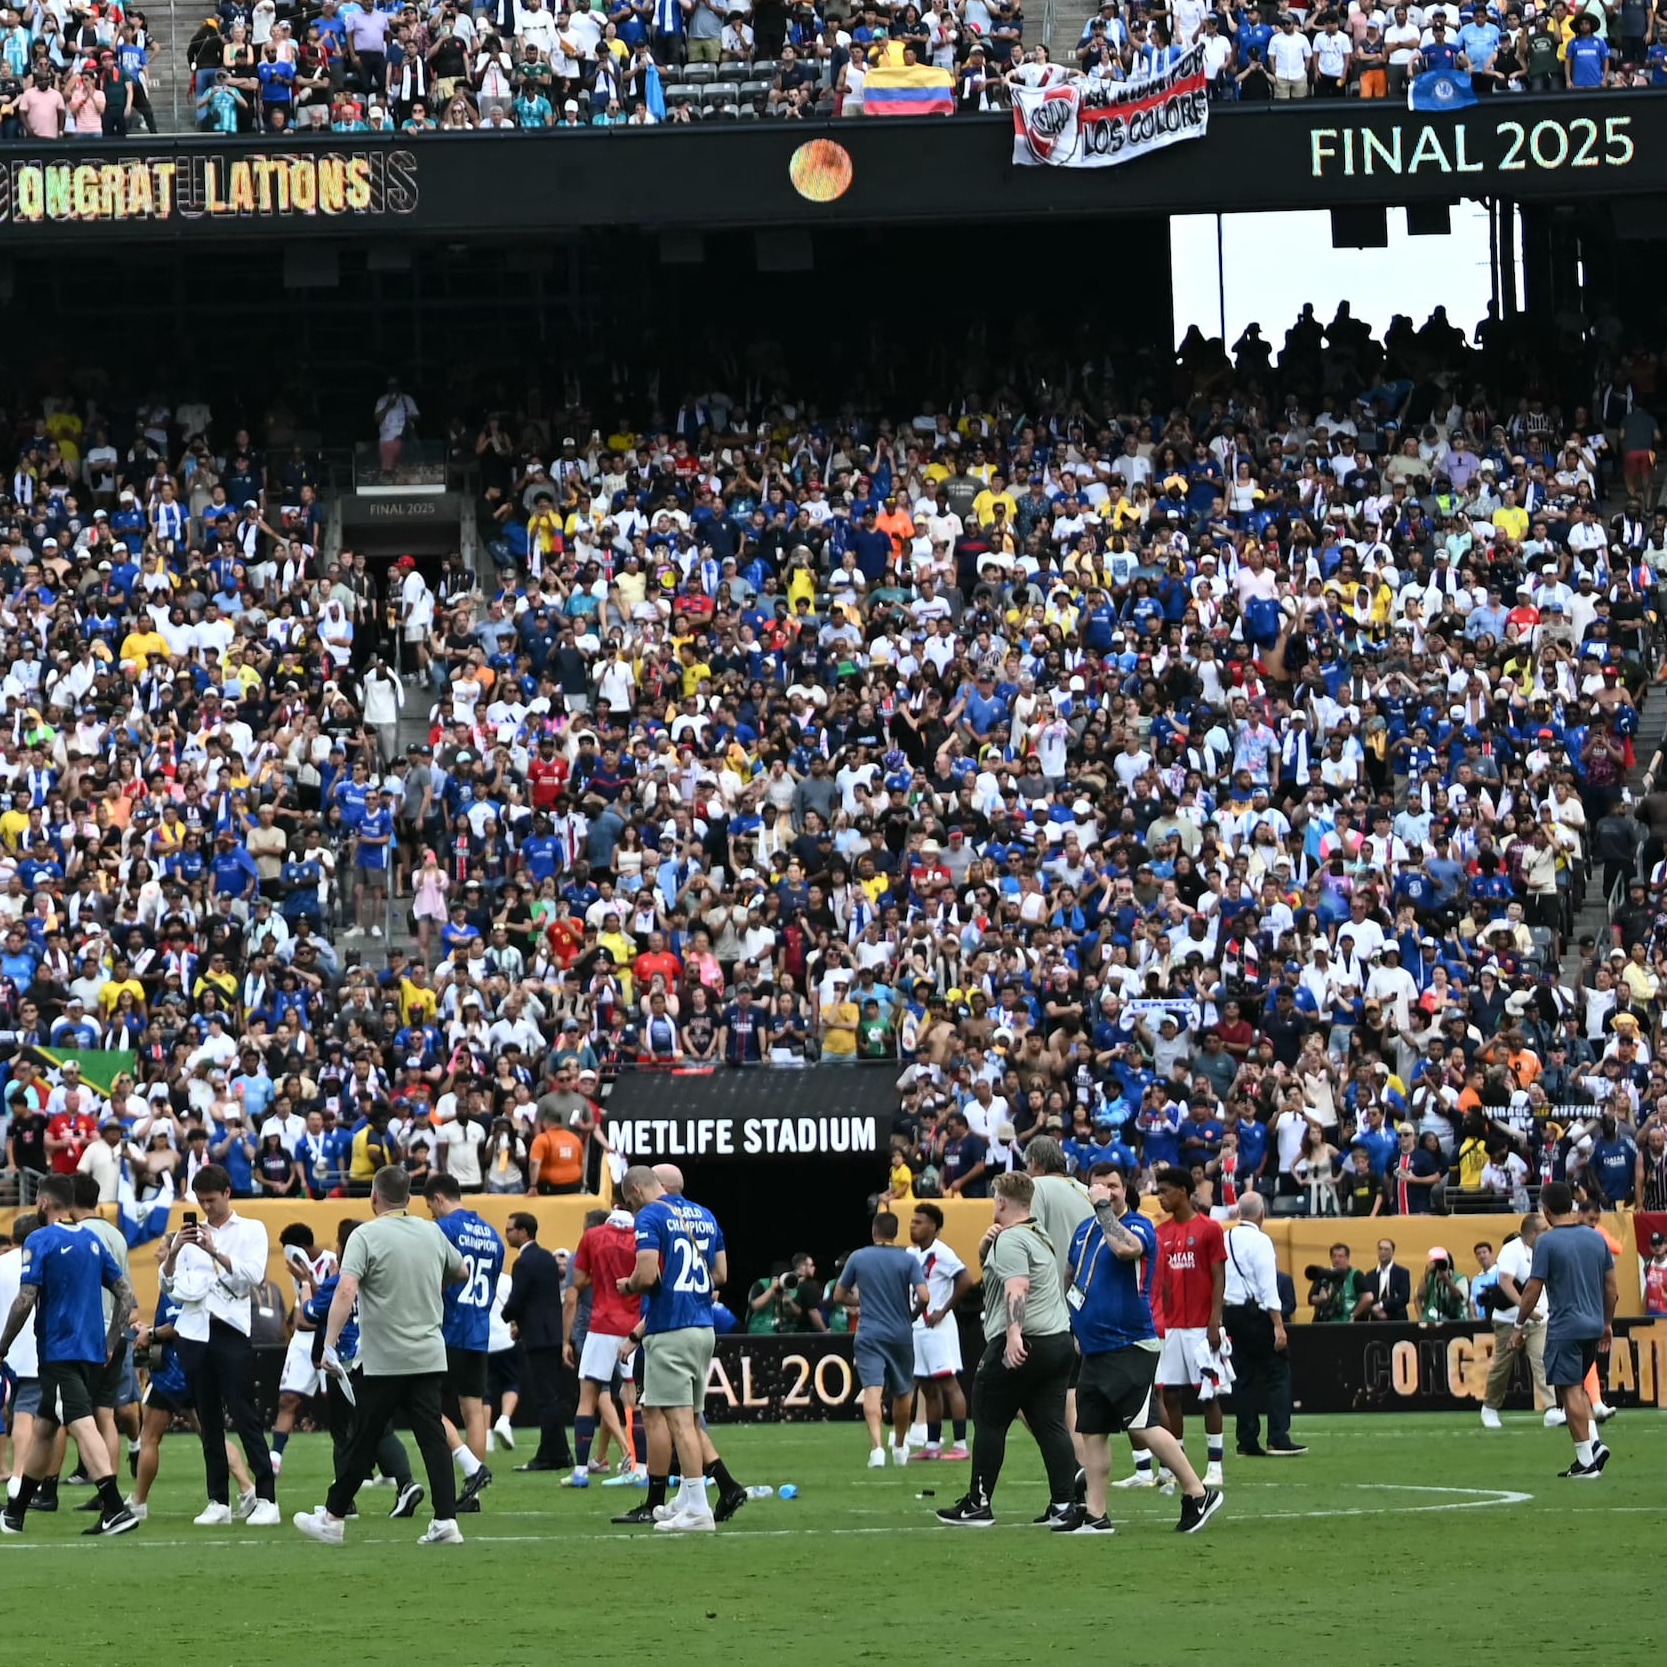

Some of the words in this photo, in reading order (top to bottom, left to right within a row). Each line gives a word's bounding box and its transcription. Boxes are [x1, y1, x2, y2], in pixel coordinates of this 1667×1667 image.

[1083, 115, 1125, 157] LOS
[1310, 124, 1485, 176] FINAL
[1496, 115, 1636, 171] 2025
[370, 503, 405, 516] FINAL
[407, 502, 436, 514] 2025
[608, 1118, 735, 1156] METLIFE
[743, 1116, 877, 1154] STADIUM
[457, 1253, 494, 1308] 25
[673, 1238, 711, 1294] 25
